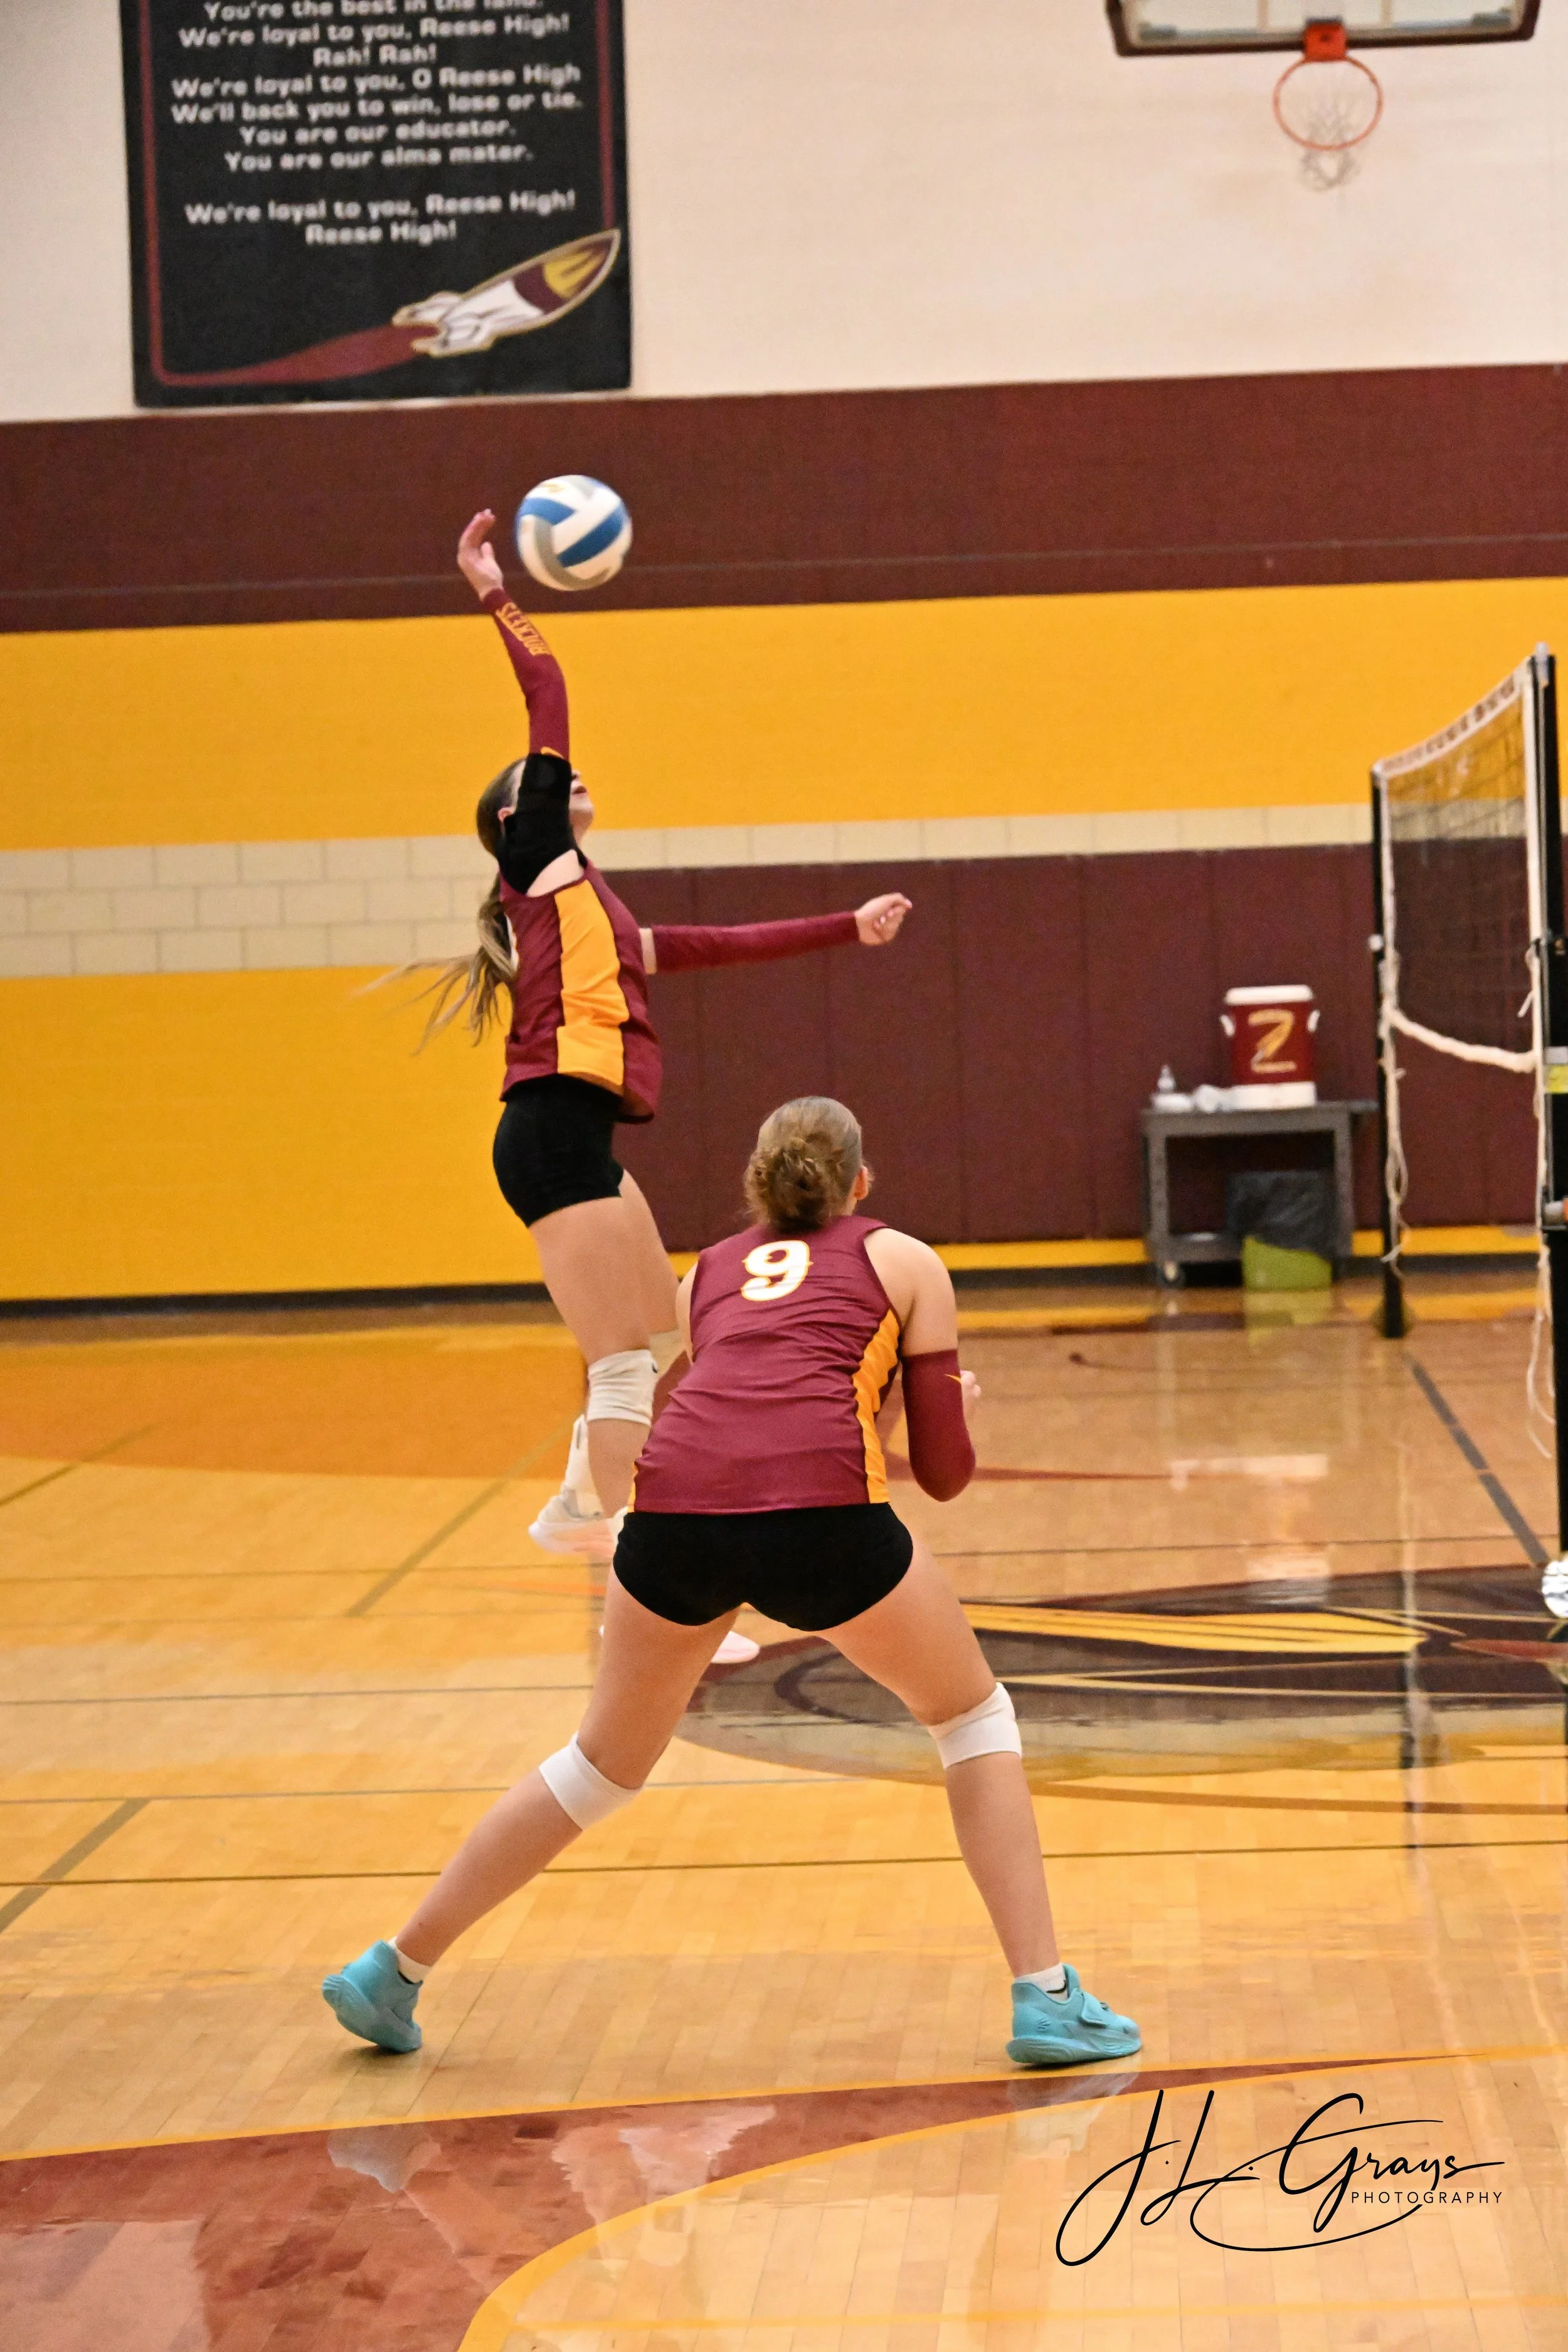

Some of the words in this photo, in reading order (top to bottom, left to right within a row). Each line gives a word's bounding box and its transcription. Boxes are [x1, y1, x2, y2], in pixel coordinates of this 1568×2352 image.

[179, 28, 255, 46] We're
[262, 24, 320, 46] loyal
[327, 25, 354, 41] to
[420, 18, 497, 37] Reese
[504, 13, 569, 37] High!
[314, 46, 370, 66] Rah!
[379, 43, 437, 63] Rah!
[171, 78, 248, 97] We're
[255, 74, 312, 97] loyal
[320, 76, 347, 92] to
[412, 68, 433, 88] O
[439, 67, 516, 87] Reese
[522, 63, 581, 92] High
[171, 102, 235, 122] We'll
[241, 100, 299, 120] back
[307, 102, 351, 122] you
[358, 100, 384, 116] to
[448, 93, 500, 112] lose
[506, 95, 536, 111] or
[239, 127, 287, 146] You
[295, 127, 338, 144] are
[344, 126, 389, 142] our
[224, 151, 272, 172] You
[280, 153, 323, 169] are
[330, 151, 374, 168] our
[380, 146, 442, 166] alma
[184, 201, 262, 224] We're
[268, 199, 327, 225] loyal
[333, 201, 361, 218] to
[425, 194, 502, 214] Reese
[509, 189, 576, 216] High!
[305, 224, 383, 245] Reese
[389, 219, 457, 246] High!
[495, 601, 552, 656] ROCKETS
[740, 1239, 813, 1301] 9
